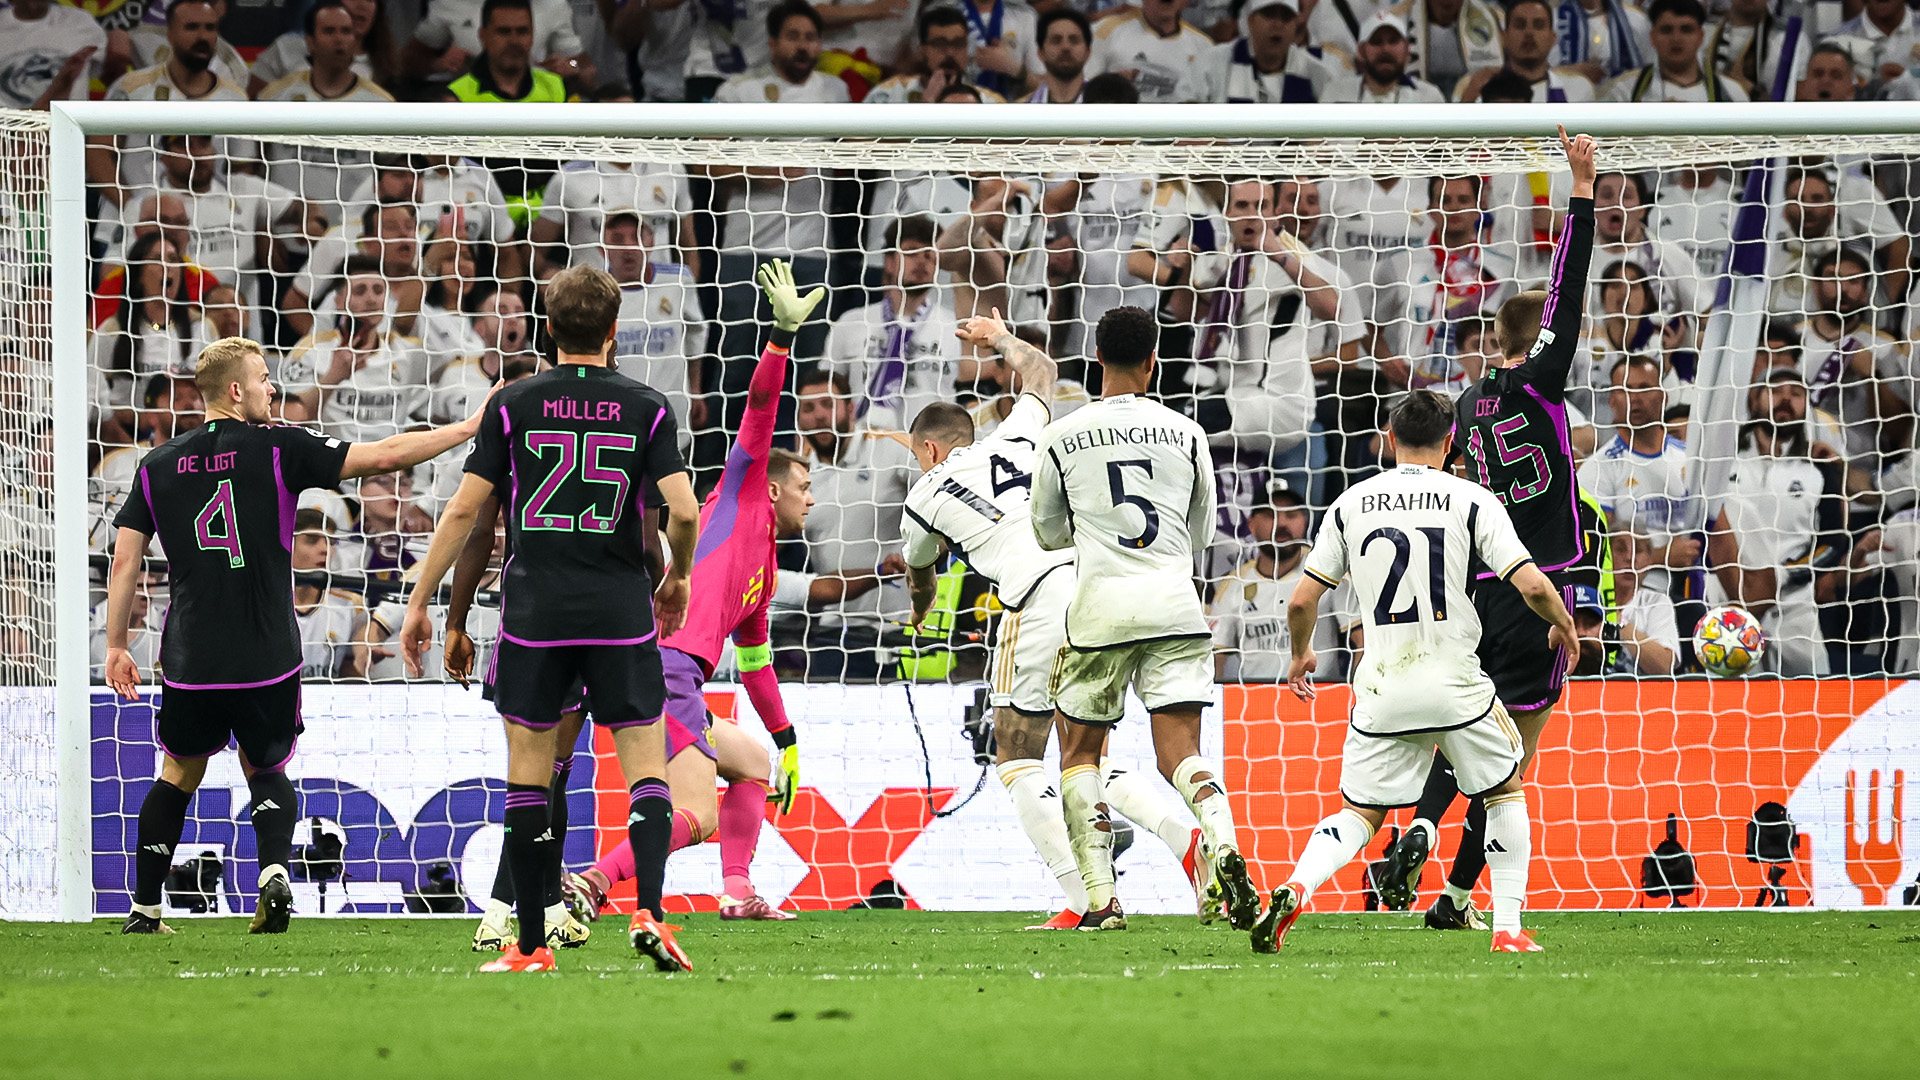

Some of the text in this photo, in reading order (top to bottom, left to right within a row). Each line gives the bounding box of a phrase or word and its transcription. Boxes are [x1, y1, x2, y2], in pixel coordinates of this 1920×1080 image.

[543, 396, 621, 421] MÜLLER
[1061, 427, 1184, 455] BELLINGHAM
[177, 451, 238, 474] DE LIGT
[521, 430, 637, 533] 25
[1106, 459, 1159, 549] 5
[1361, 492, 1450, 514] BRAHIM
[1467, 412, 1552, 506] 15
[194, 479, 245, 569] 4
[1360, 526, 1448, 626] 21
